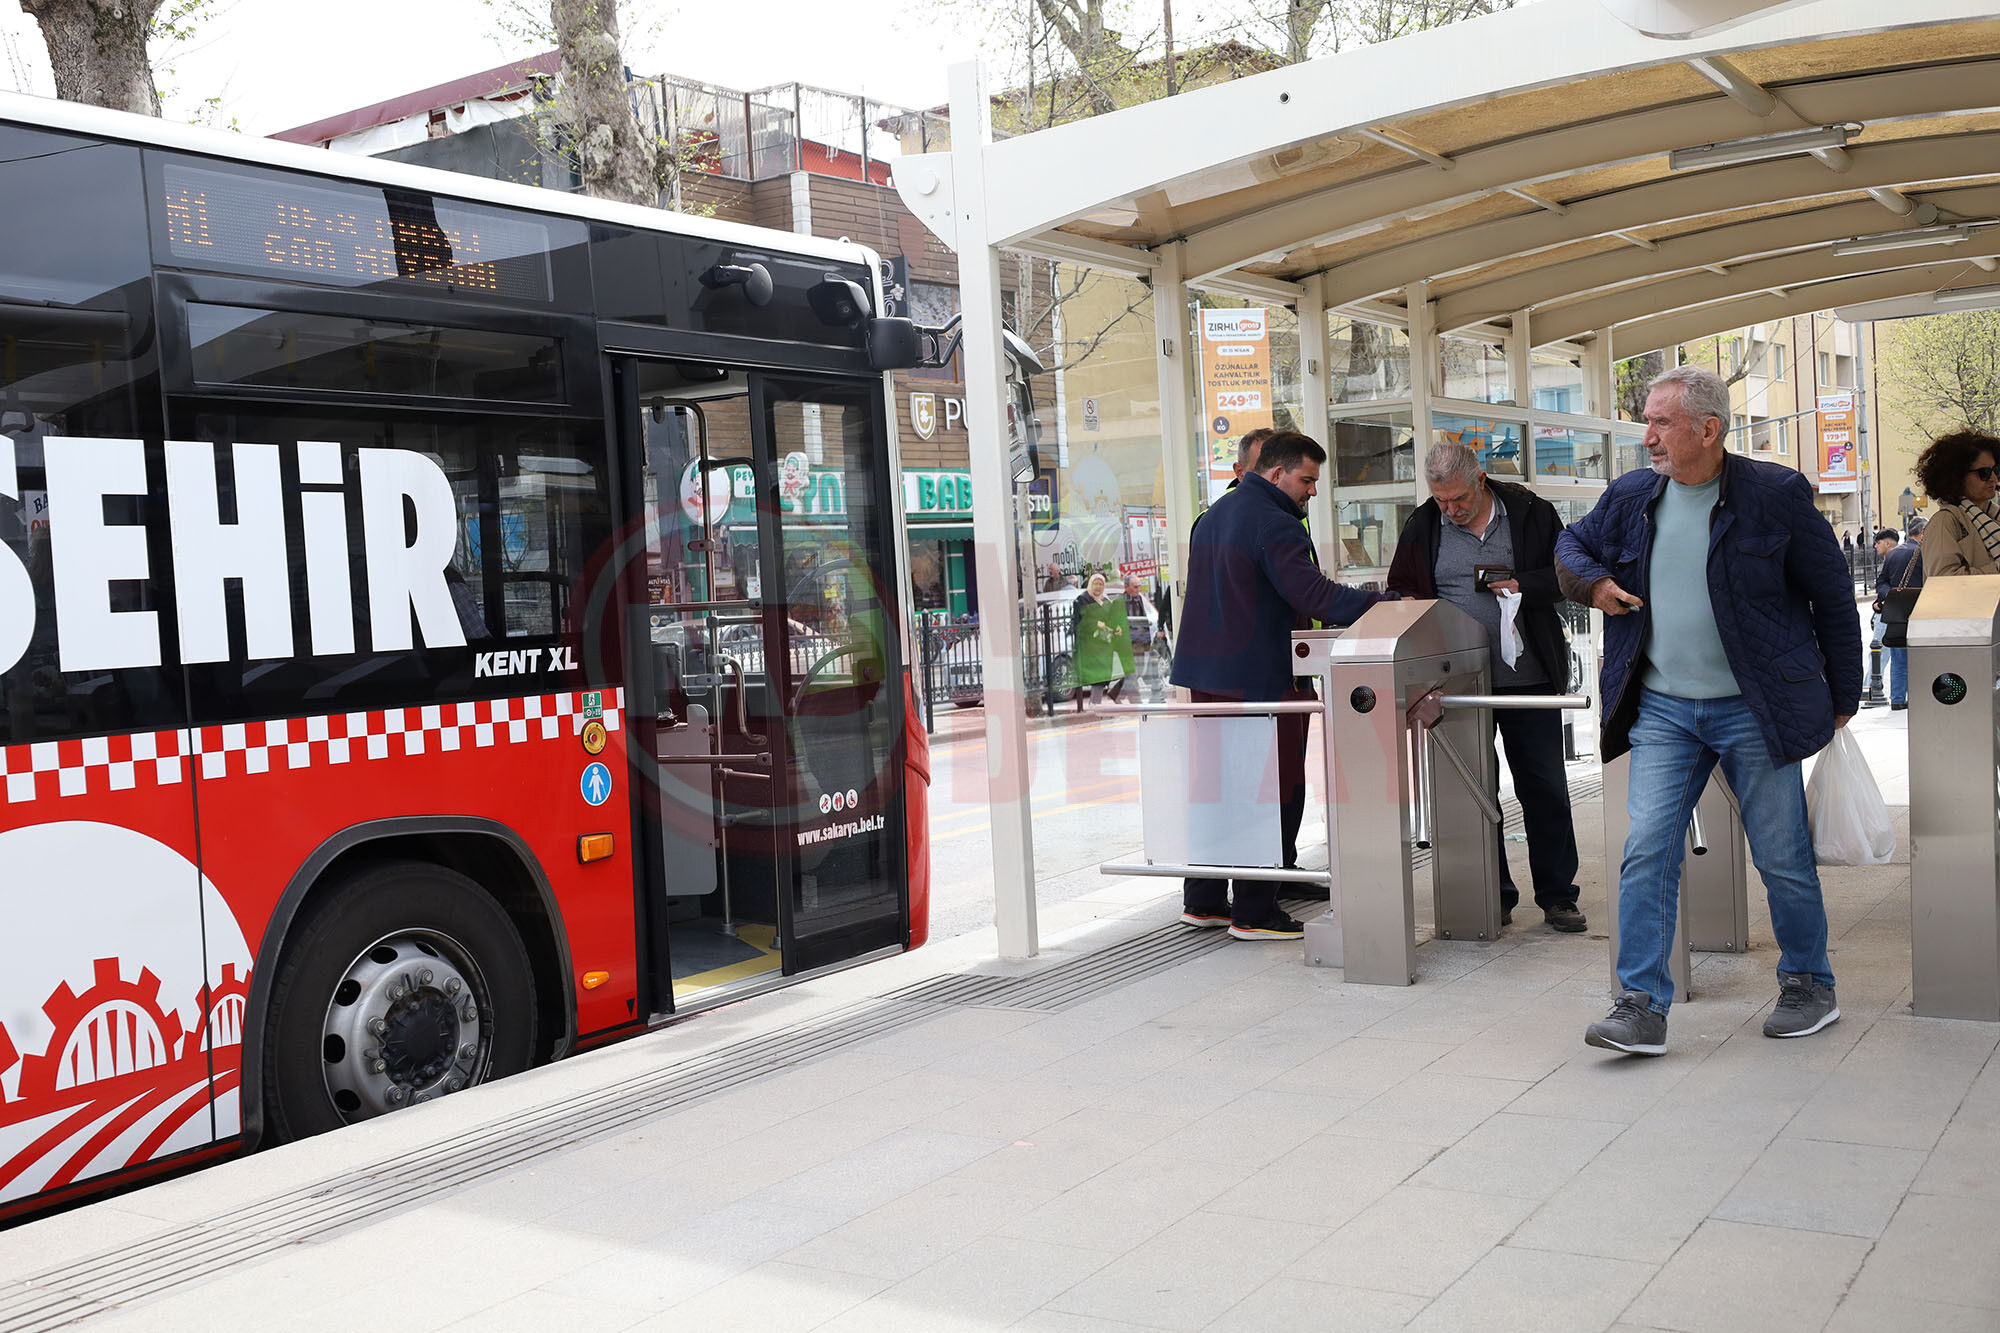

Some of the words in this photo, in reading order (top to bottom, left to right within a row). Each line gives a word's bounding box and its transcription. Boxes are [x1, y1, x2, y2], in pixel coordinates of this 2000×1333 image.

[474, 648, 542, 678] KENT
[547, 646, 578, 672] XL
[797, 814, 885, 846] www.sakarya.bel.tr
